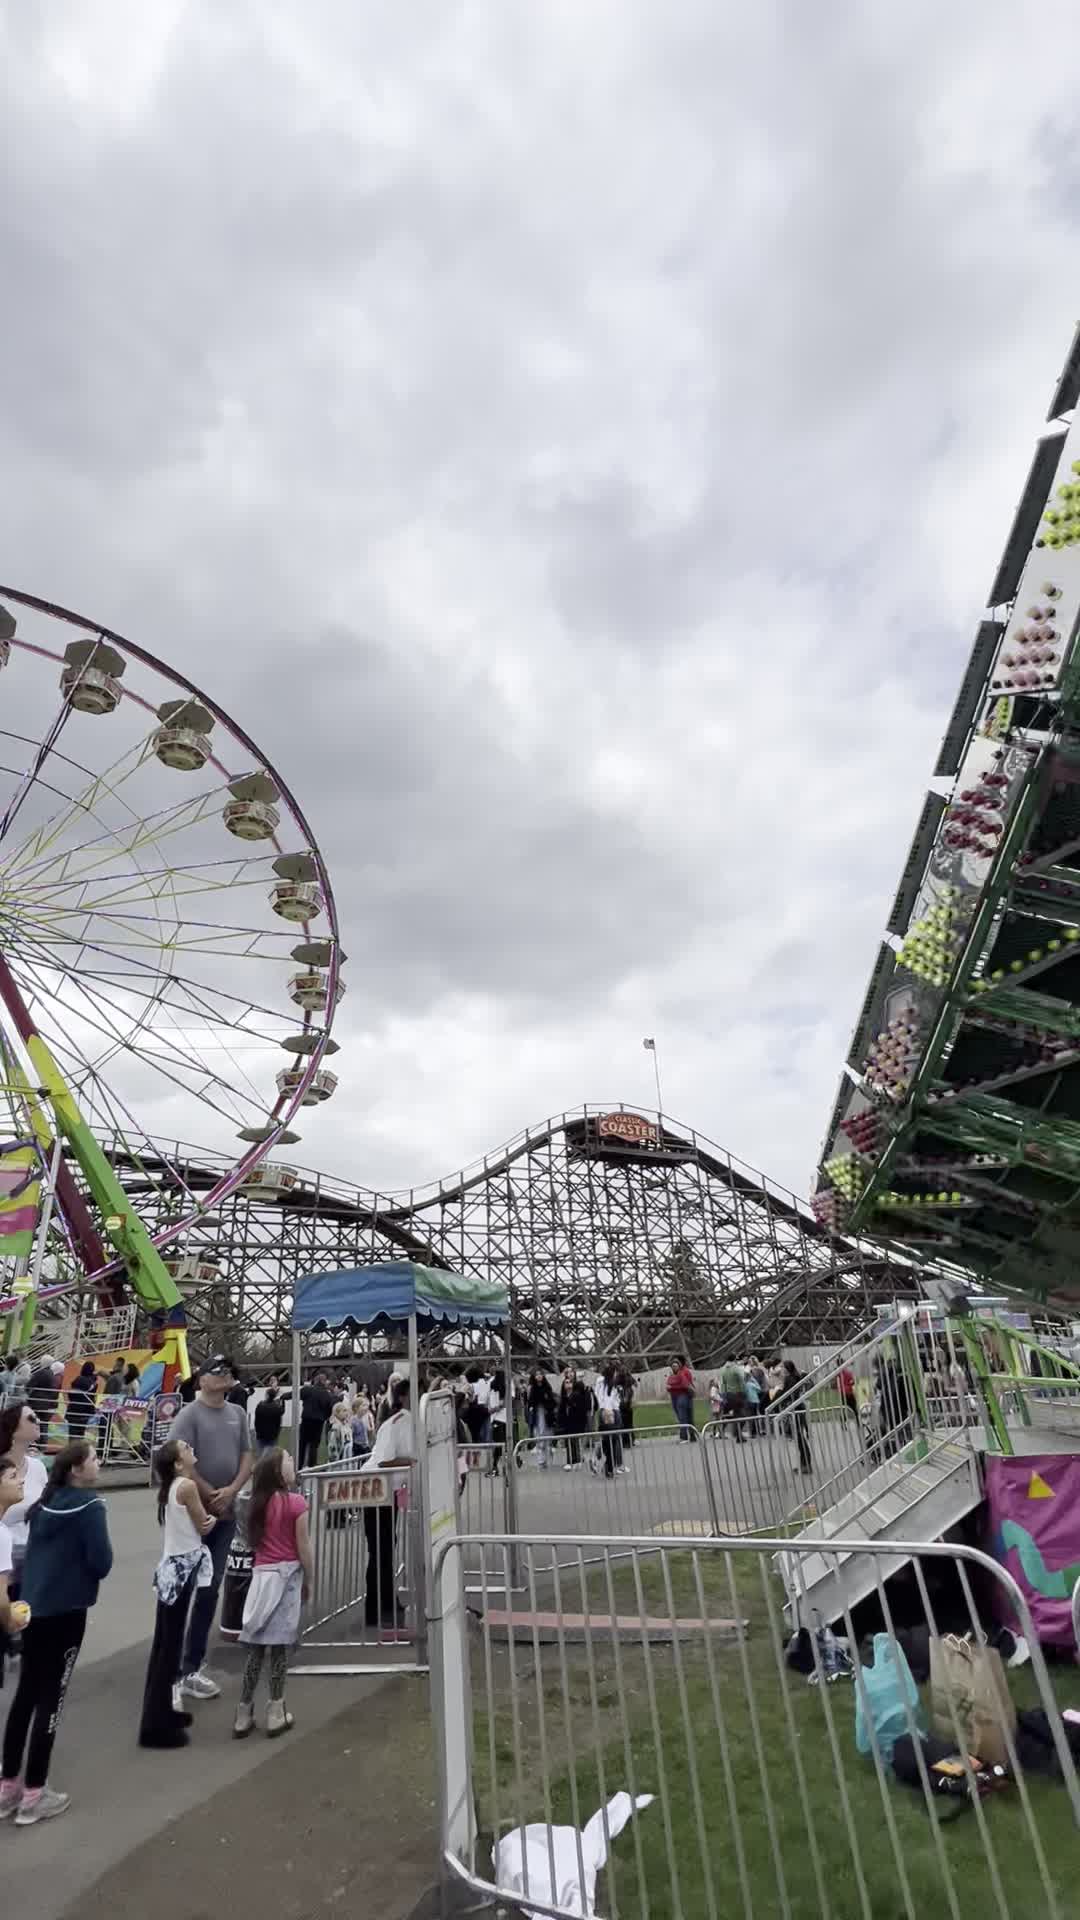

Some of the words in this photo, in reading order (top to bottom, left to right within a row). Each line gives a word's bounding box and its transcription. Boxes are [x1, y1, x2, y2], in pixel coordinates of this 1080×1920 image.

[615, 1115, 641, 1125] CLASSIC
[600, 1121, 656, 1136] COASTER
[124, 1398, 149, 1408] ENTER
[327, 1478, 384, 1500] ENTER
